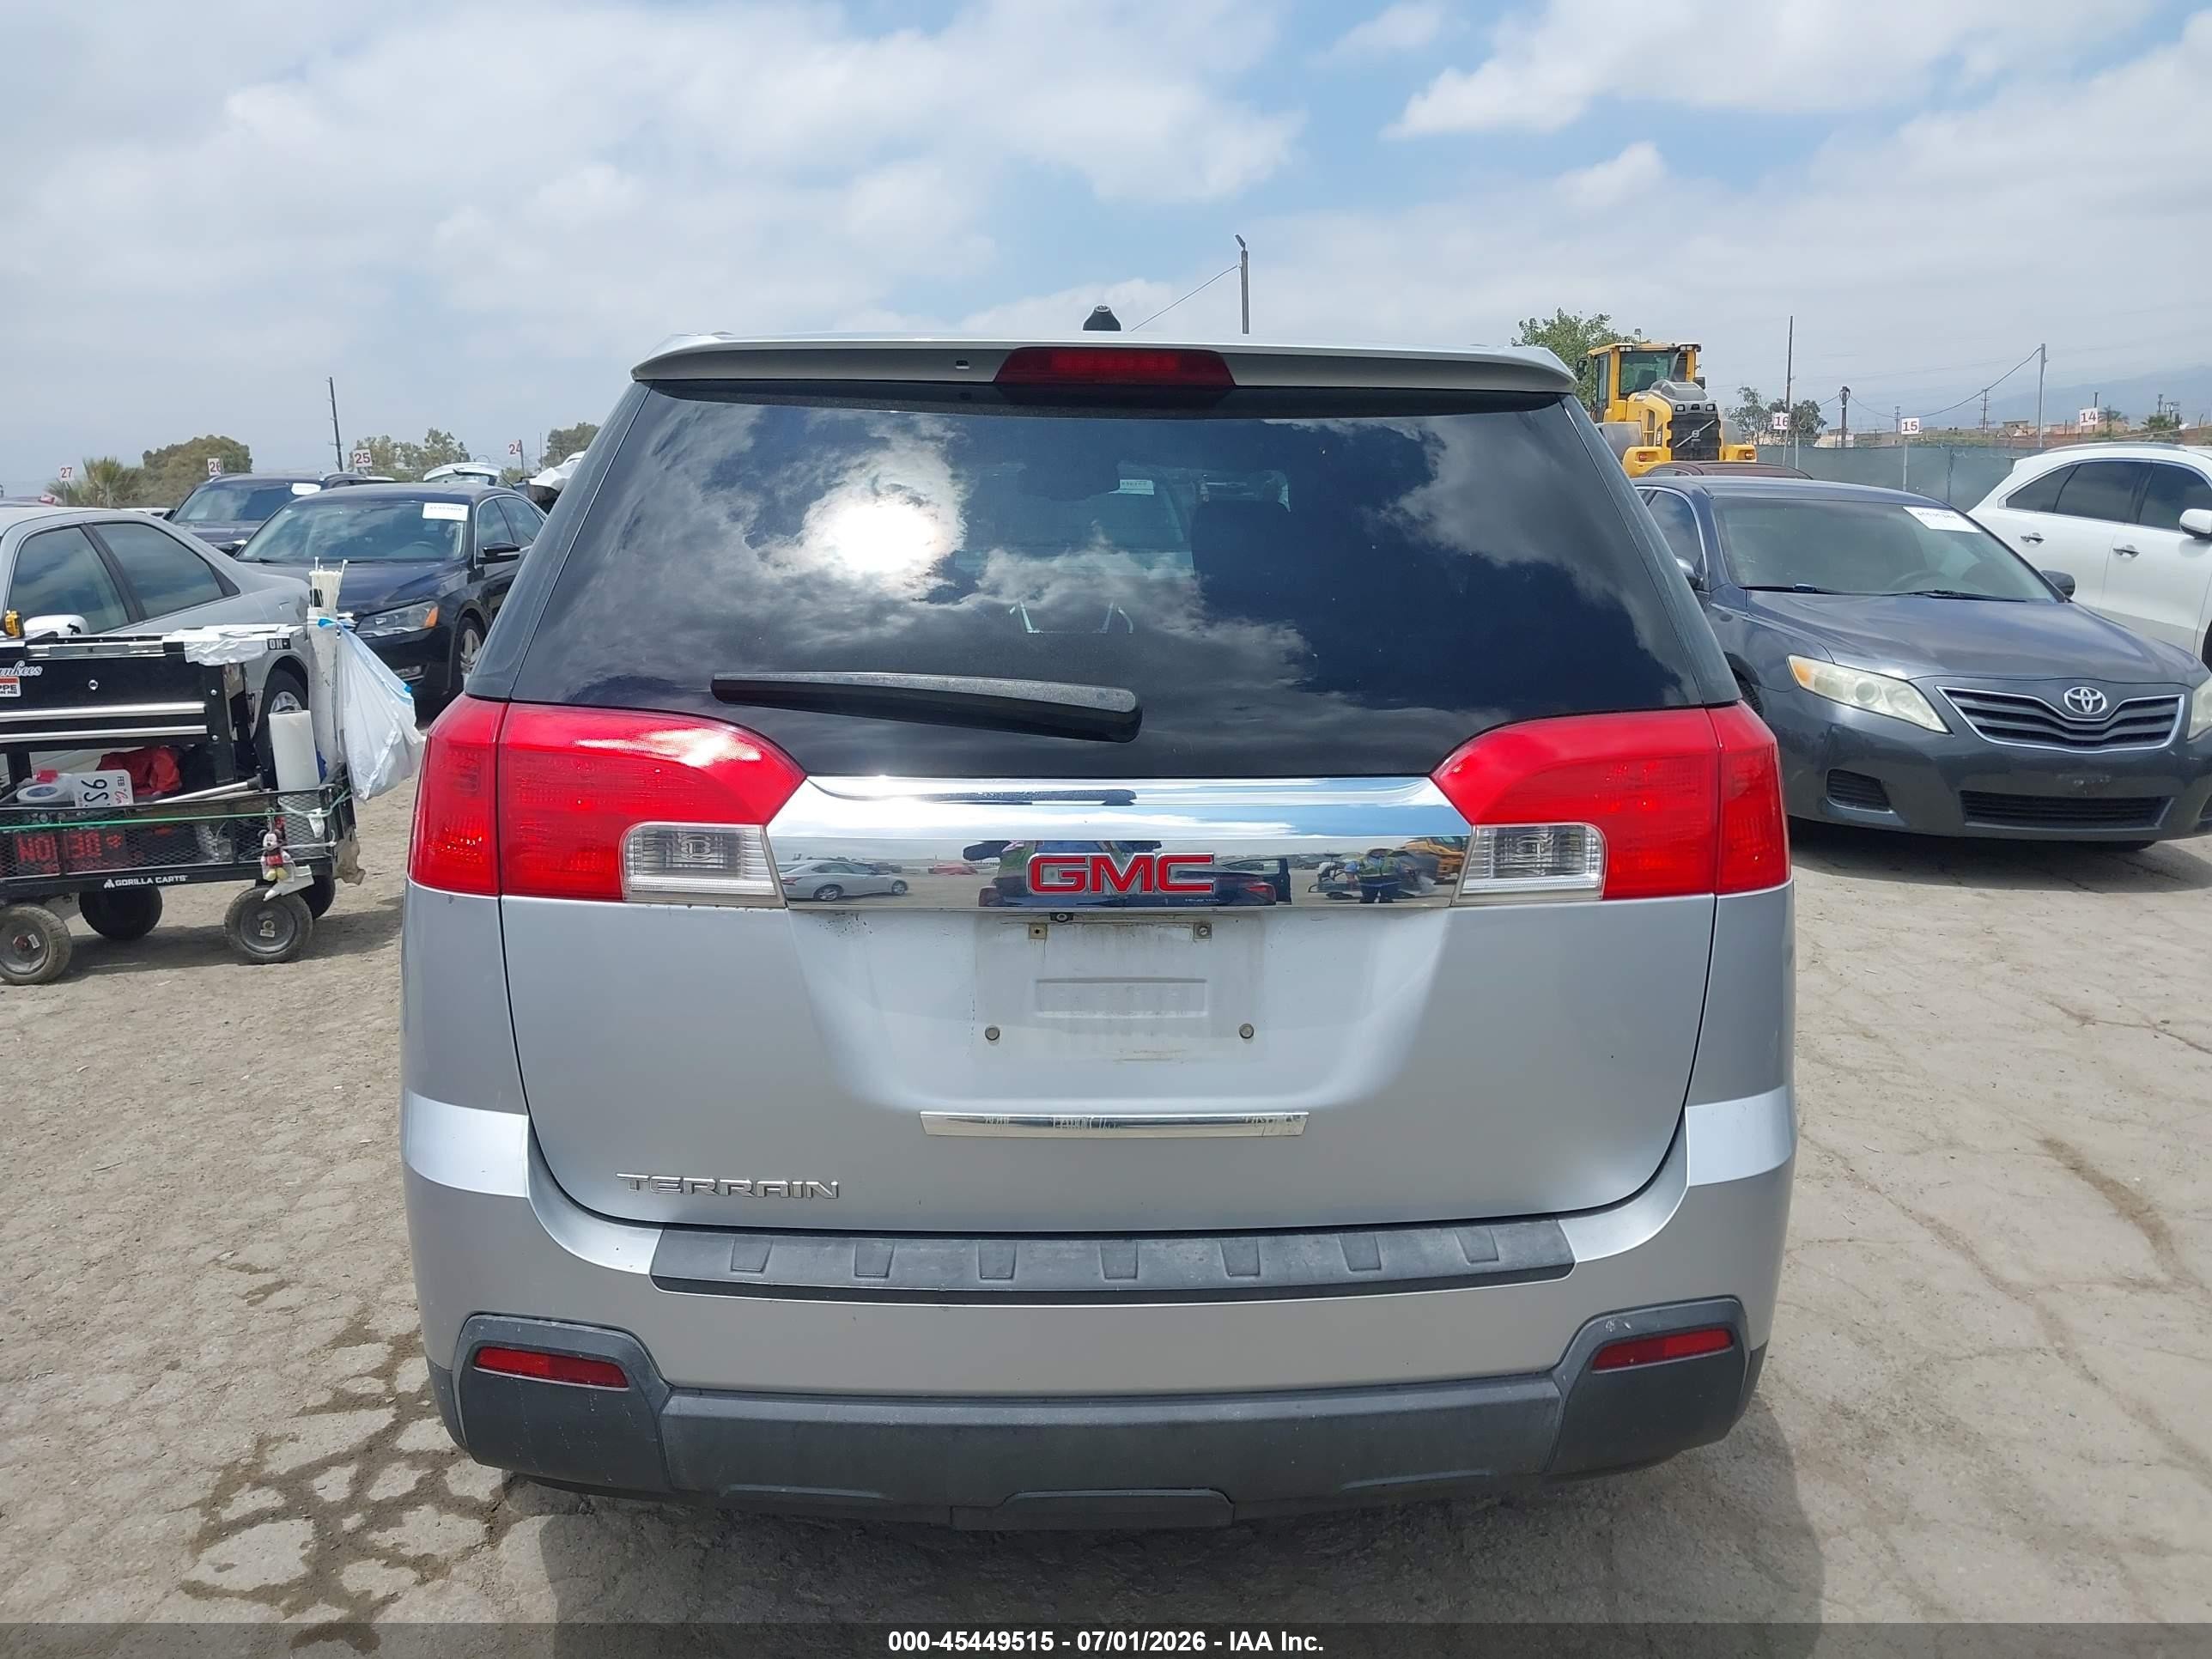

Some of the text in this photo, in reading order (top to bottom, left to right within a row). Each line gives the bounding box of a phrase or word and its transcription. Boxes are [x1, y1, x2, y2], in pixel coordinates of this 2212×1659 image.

[1774, 416, 1789, 427] 16
[2081, 411, 2097, 423] 14
[1902, 421, 1918, 432] 15
[354, 453, 371, 464] 25
[60, 466, 73, 478] 27
[117, 775, 125, 787] FEB
[81, 778, 111, 807] 9S
[1026, 852, 1215, 894] GMC
[114, 875, 186, 887] GORILLA CARTS
[616, 1172, 840, 1200] TERRAIN
